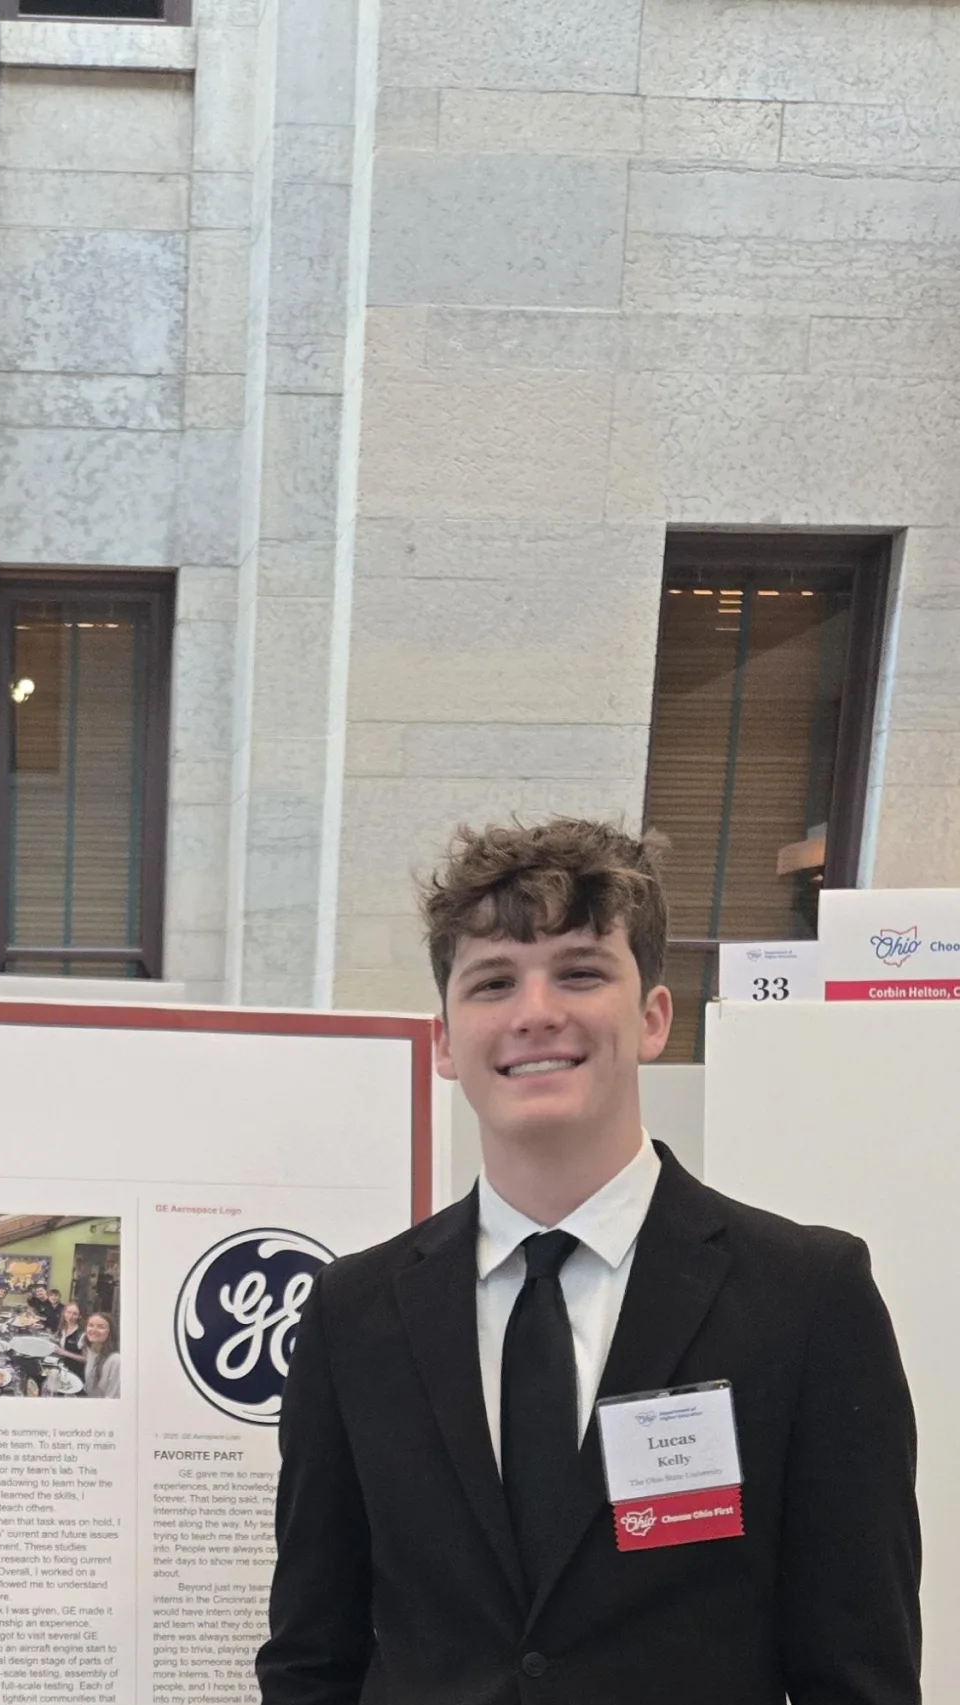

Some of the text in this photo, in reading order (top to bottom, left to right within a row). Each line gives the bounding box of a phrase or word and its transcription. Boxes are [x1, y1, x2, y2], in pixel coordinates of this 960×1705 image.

[870, 935, 922, 960] Ohio
[752, 977, 790, 1001] 33
[868, 986, 906, 998] Corbin
[907, 986, 951, 998] Helton,
[155, 1205, 242, 1216] GE Aerospace Logo
[647, 1434, 696, 1450] Lucas
[21, 1452, 61, 1462] standard
[63, 1452, 78, 1462] lab
[154, 1450, 244, 1461] FAVORITE PART
[657, 1453, 692, 1467] Kelly
[195, 1471, 218, 1480] gave
[249, 1471, 273, 1481] many
[629, 1479, 644, 1487] The
[646, 1477, 664, 1485] Ohio
[665, 1473, 683, 1482] State
[620, 1515, 658, 1533] Ohio
[693, 1509, 713, 1519] Ohio
[714, 1506, 734, 1516] First
[24, 1541, 52, 1551] These
[54, 1542, 87, 1551] studies
[153, 1693, 169, 1702] into
[243, 1693, 257, 1702] life
